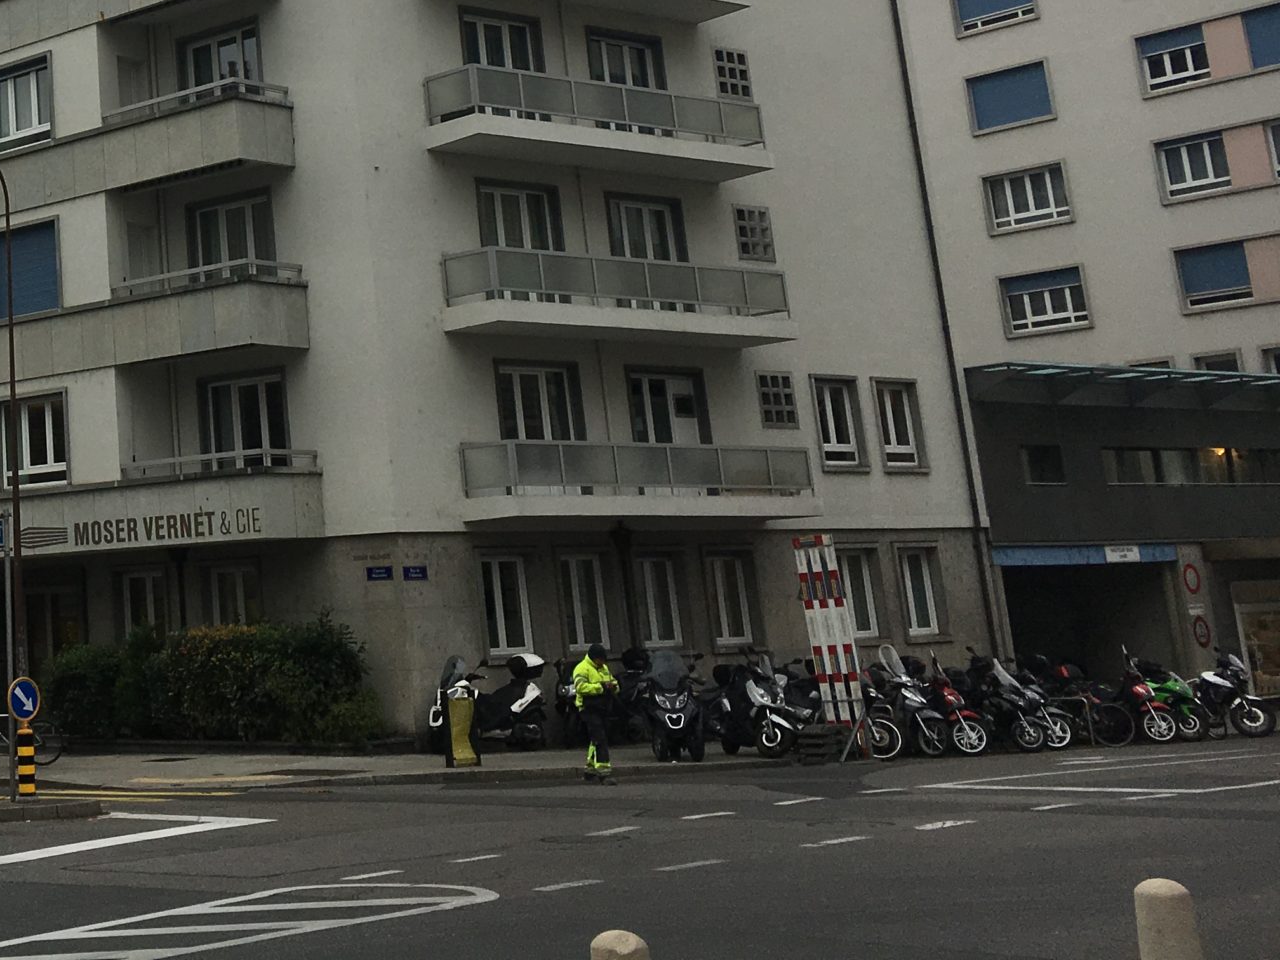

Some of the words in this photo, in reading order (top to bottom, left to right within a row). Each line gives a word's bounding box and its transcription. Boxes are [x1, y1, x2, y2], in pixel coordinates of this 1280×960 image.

[74, 517, 138, 546] MOSER
[219, 511, 231, 535] &
[236, 507, 261, 534] CIE
